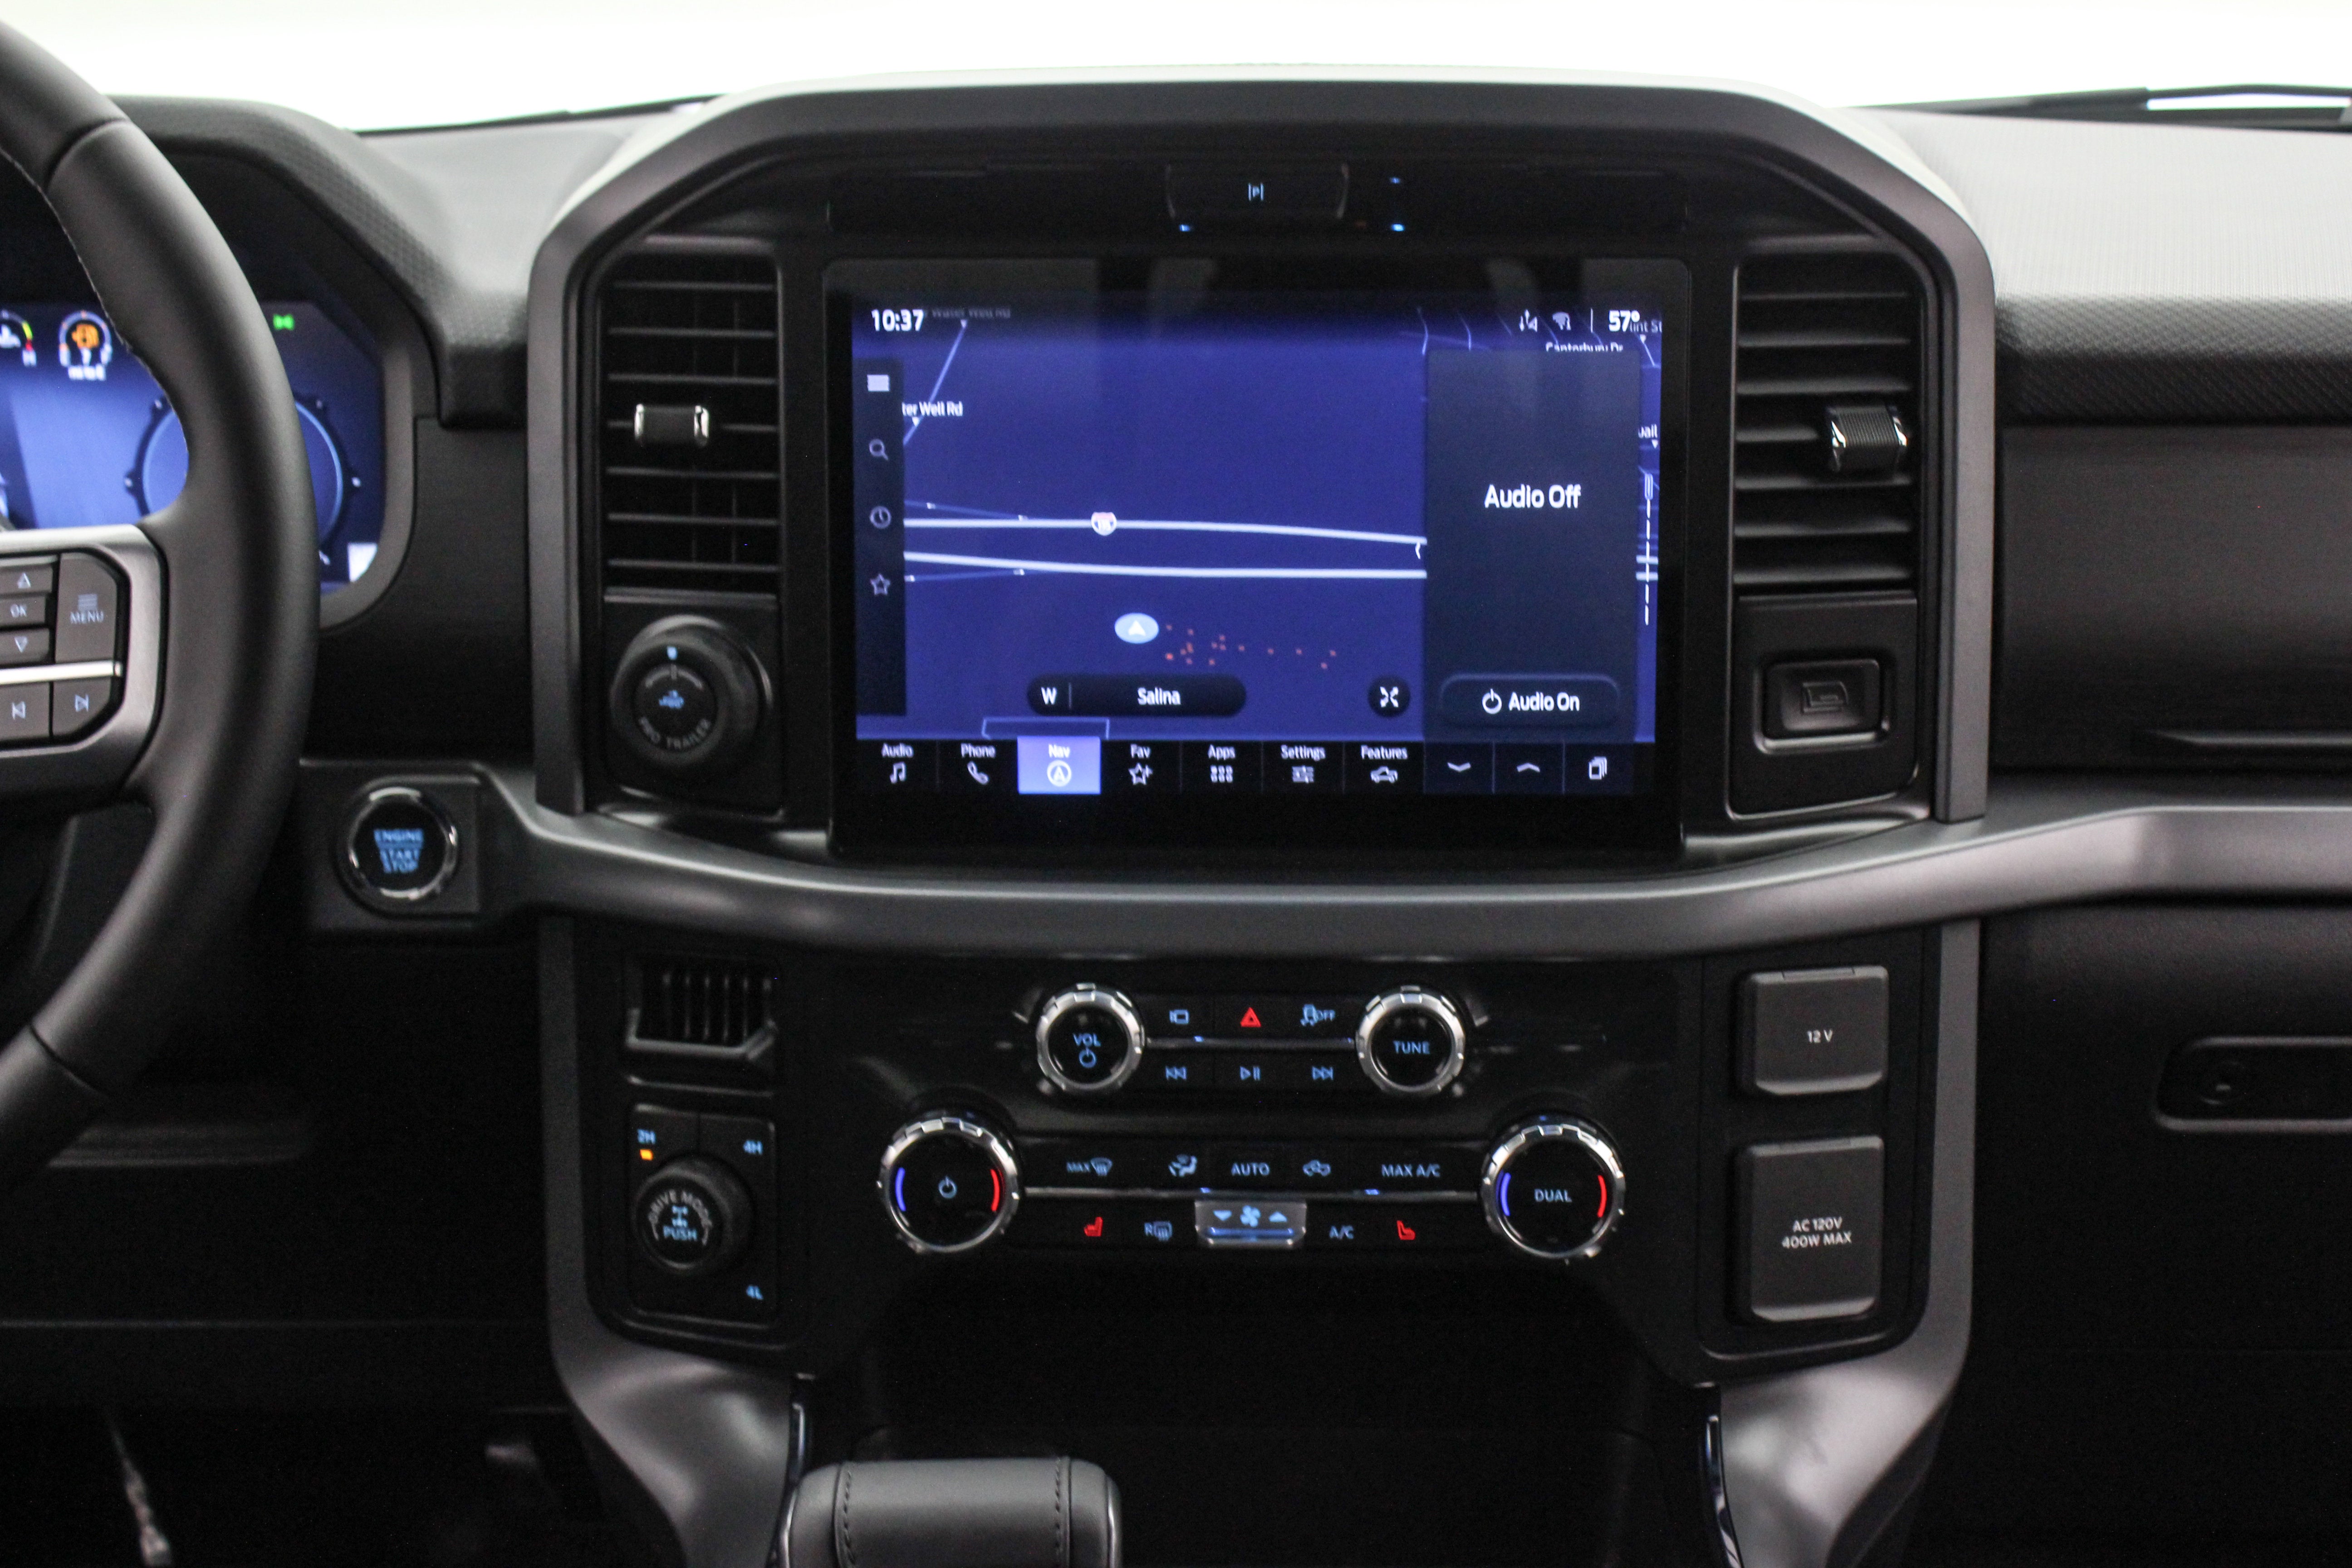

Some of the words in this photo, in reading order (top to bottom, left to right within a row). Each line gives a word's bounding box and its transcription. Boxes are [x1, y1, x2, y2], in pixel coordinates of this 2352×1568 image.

[871, 309, 924, 332] 10:37
[919, 401, 945, 417] Well
[946, 401, 963, 417] Rd
[1484, 484, 1545, 509] Audio
[1548, 484, 1582, 509] Off
[10, 603, 27, 618] OK
[69, 610, 104, 624] MENU
[1041, 686, 1057, 705] W
[1137, 686, 1181, 705] Salina
[1508, 691, 1555, 711] Audio
[1556, 691, 1580, 711] On
[881, 743, 914, 758] Audio
[960, 743, 996, 758] Phone
[1048, 744, 1071, 758] Nav
[1130, 744, 1152, 759] Fav
[1208, 744, 1236, 760] Apps
[1280, 744, 1326, 761] Settings
[1361, 745, 1408, 760] Features
[1316, 1009, 1336, 1021] OFF
[1073, 1033, 1101, 1047] VOL
[1807, 1029, 1821, 1043] 12
[1823, 1029, 1833, 1043] V
[1393, 1041, 1431, 1054] TUNE
[1067, 1161, 1089, 1173] MAX
[1231, 1162, 1270, 1176] AUTO
[1382, 1163, 1413, 1177] MAX
[1416, 1163, 1441, 1178] A/C
[1534, 1188, 1573, 1203] DUAL
[1793, 1218, 1811, 1233] AC
[1812, 1216, 1843, 1231] 120V
[663, 1225, 698, 1242] PUSH
[1329, 1225, 1355, 1240] A/C
[1781, 1234, 1820, 1250] 400W
[1823, 1230, 1852, 1246] MAX
